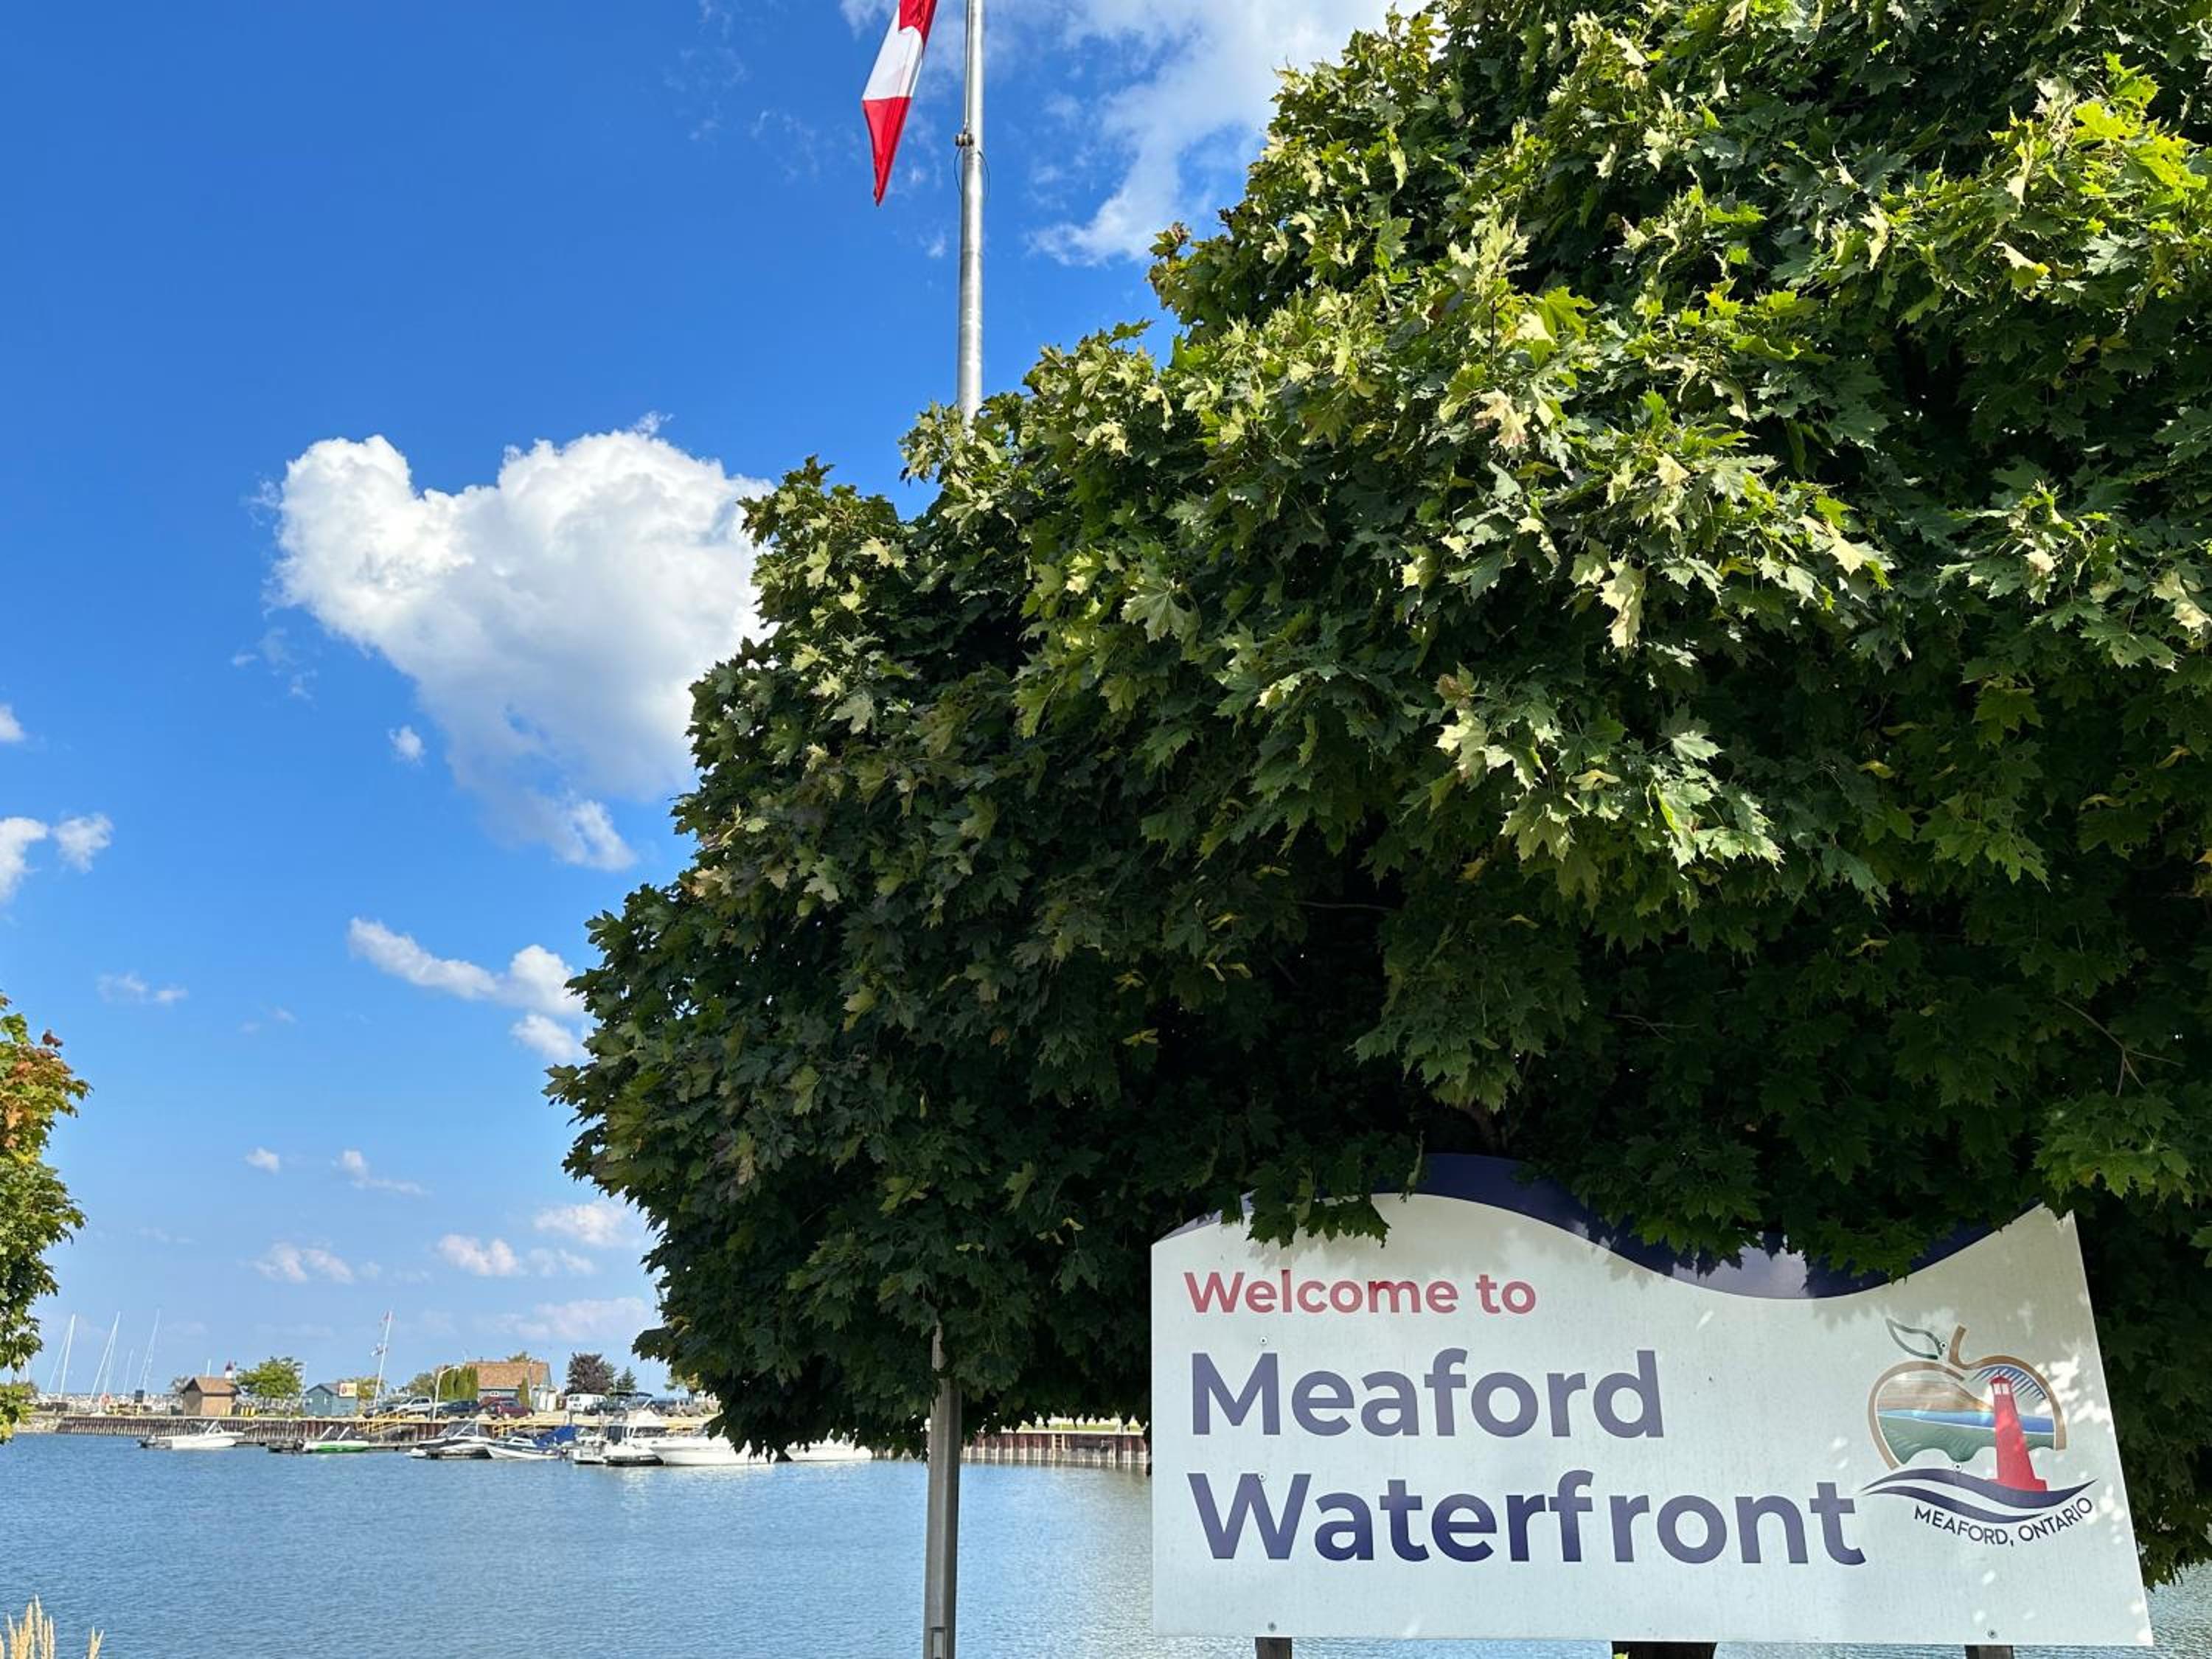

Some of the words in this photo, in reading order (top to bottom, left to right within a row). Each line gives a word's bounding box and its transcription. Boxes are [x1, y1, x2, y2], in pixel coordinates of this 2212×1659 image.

[1183, 1269, 1458, 1314] Welcome
[1475, 1274, 1537, 1314] to
[1191, 1347, 1664, 1438] Meaford
[1187, 1470, 1866, 1565] Waterfront
[1914, 1504, 2014, 1546] MEAFORD,
[2017, 1496, 2093, 1542] ONTARIO
